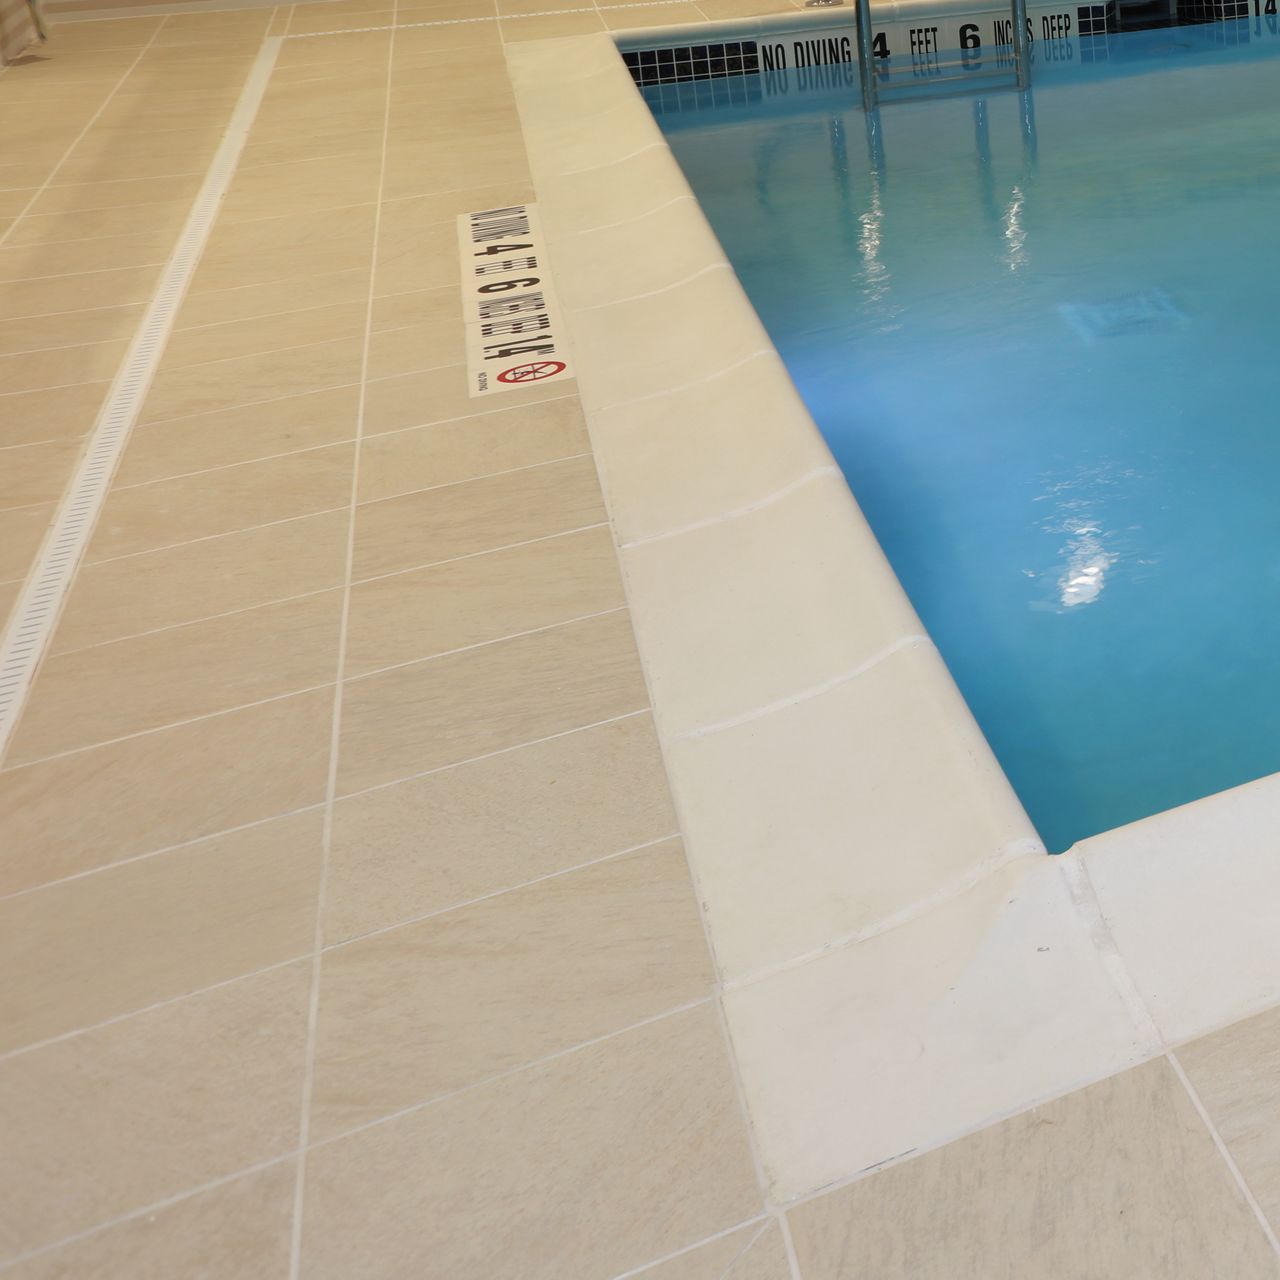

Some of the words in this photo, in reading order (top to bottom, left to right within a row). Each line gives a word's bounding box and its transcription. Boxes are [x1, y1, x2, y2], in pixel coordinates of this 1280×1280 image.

[761, 43, 787, 72] NO
[793, 36, 852, 68] DIVING
[872, 32, 891, 59] 4
[910, 27, 938, 56] FEET
[958, 23, 981, 50] 6
[993, 17, 1034, 46] INCS
[1042, 13, 1072, 41] DEEP
[474, 244, 534, 256] 4
[475, 256, 537, 276] FEET
[477, 277, 540, 293] 6
[481, 313, 551, 337] DEEP
